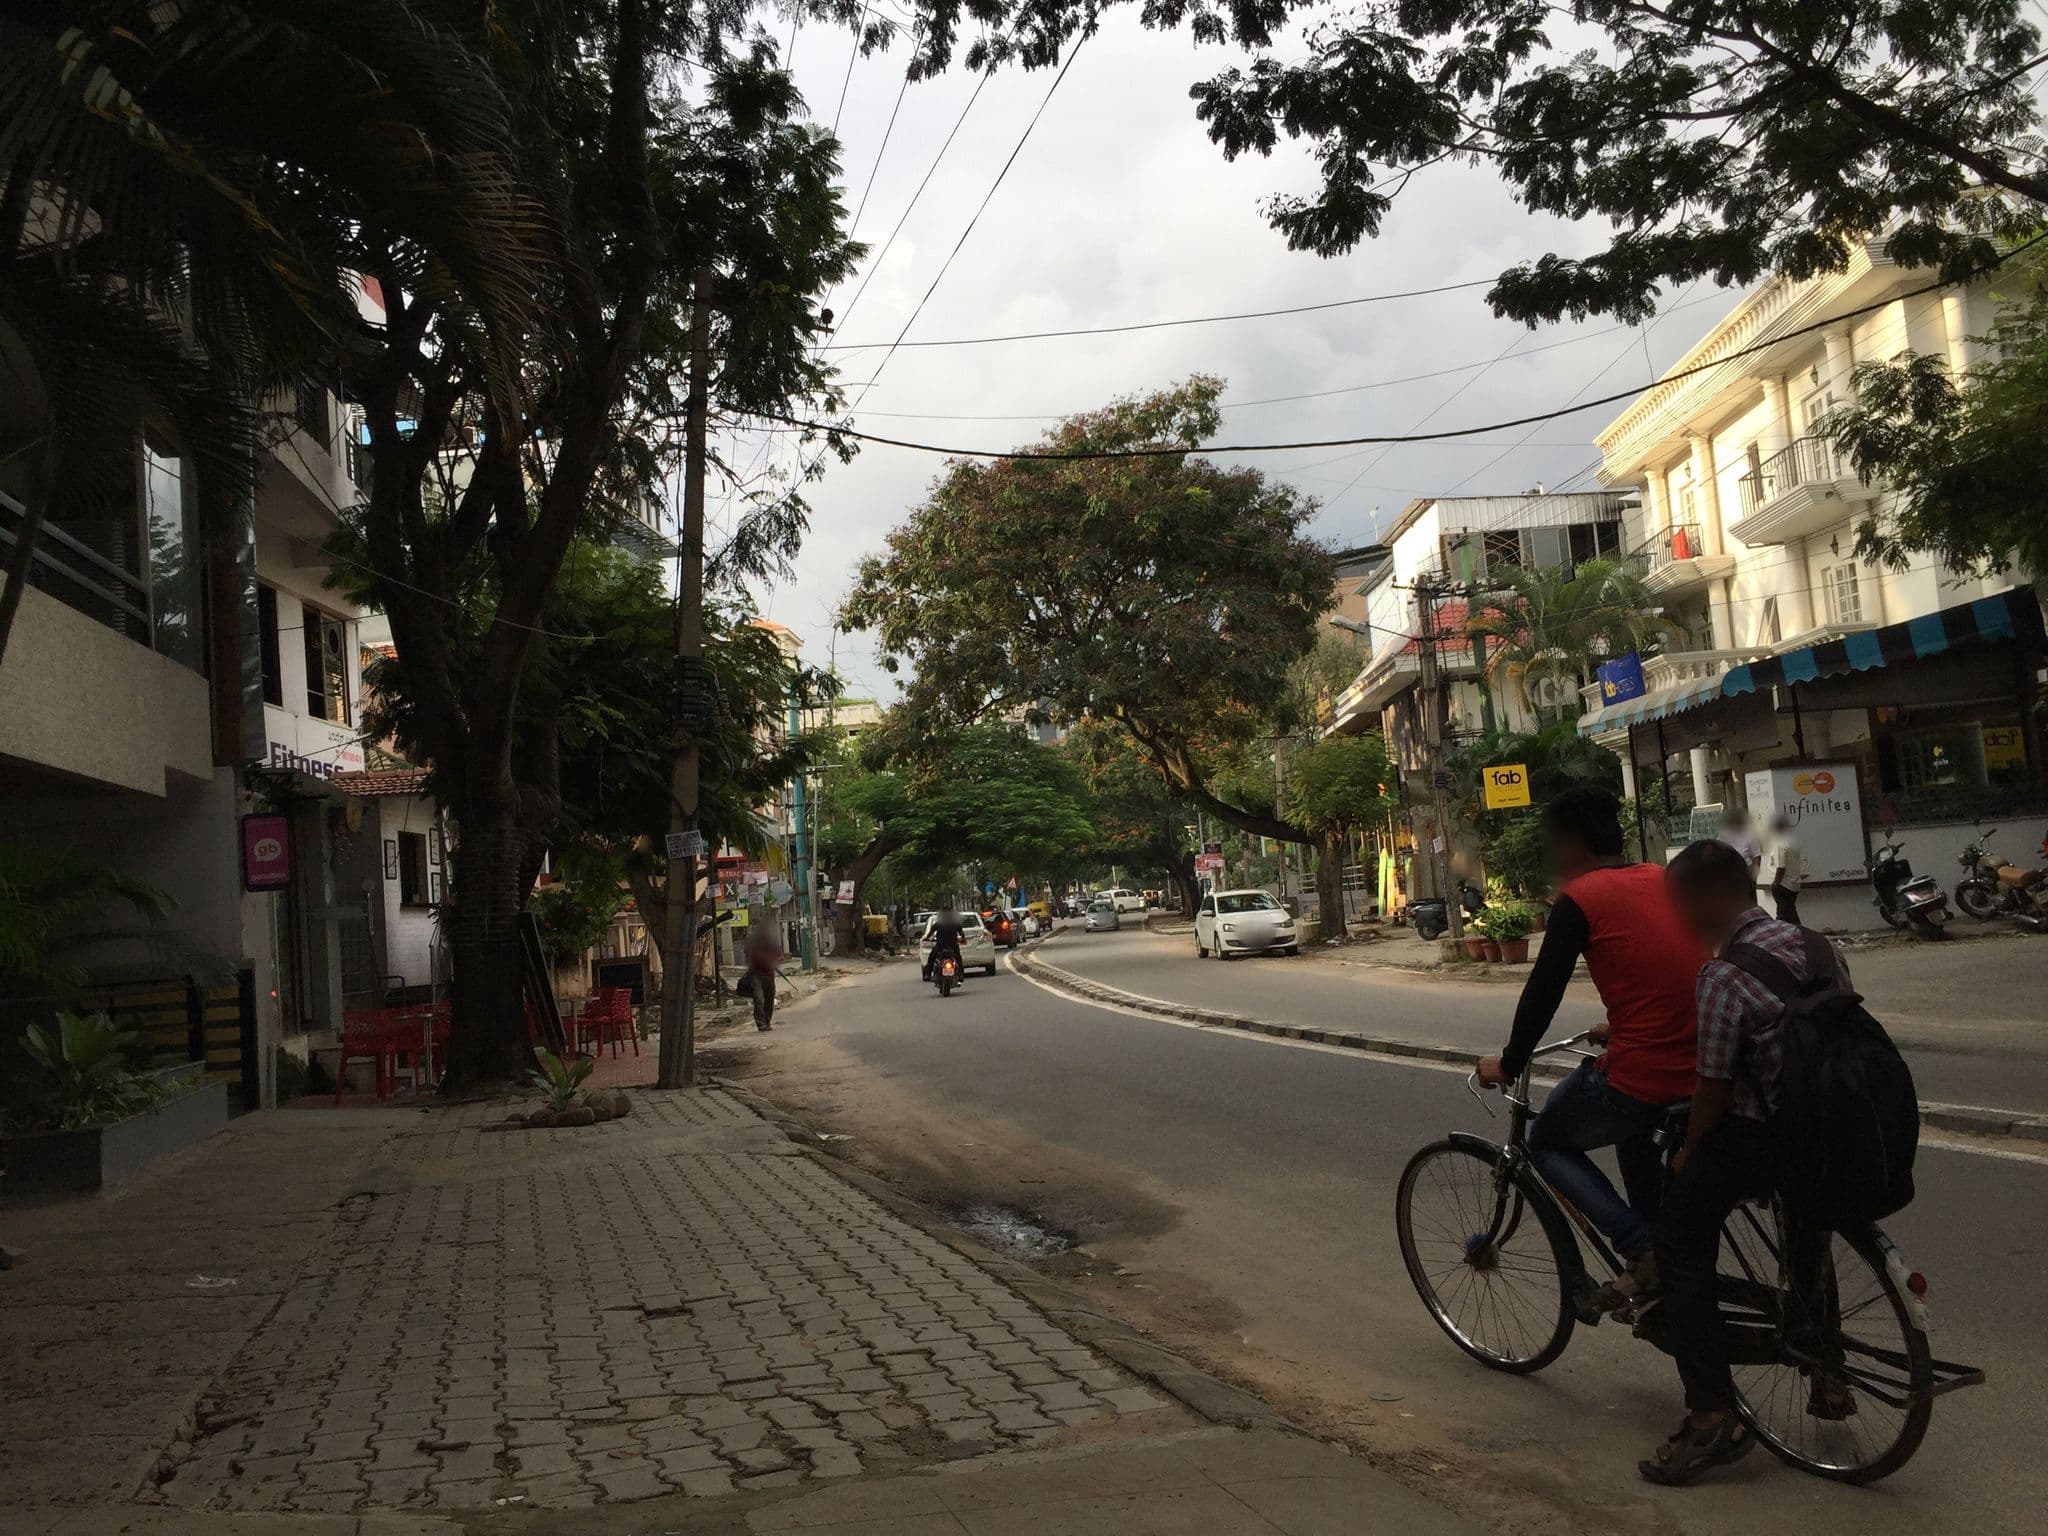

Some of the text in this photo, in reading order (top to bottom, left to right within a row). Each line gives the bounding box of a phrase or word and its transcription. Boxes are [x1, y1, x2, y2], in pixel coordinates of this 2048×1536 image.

[1491, 770, 1521, 785] fab
[1783, 797, 1851, 829] infinitea
[258, 843, 277, 856] gb
